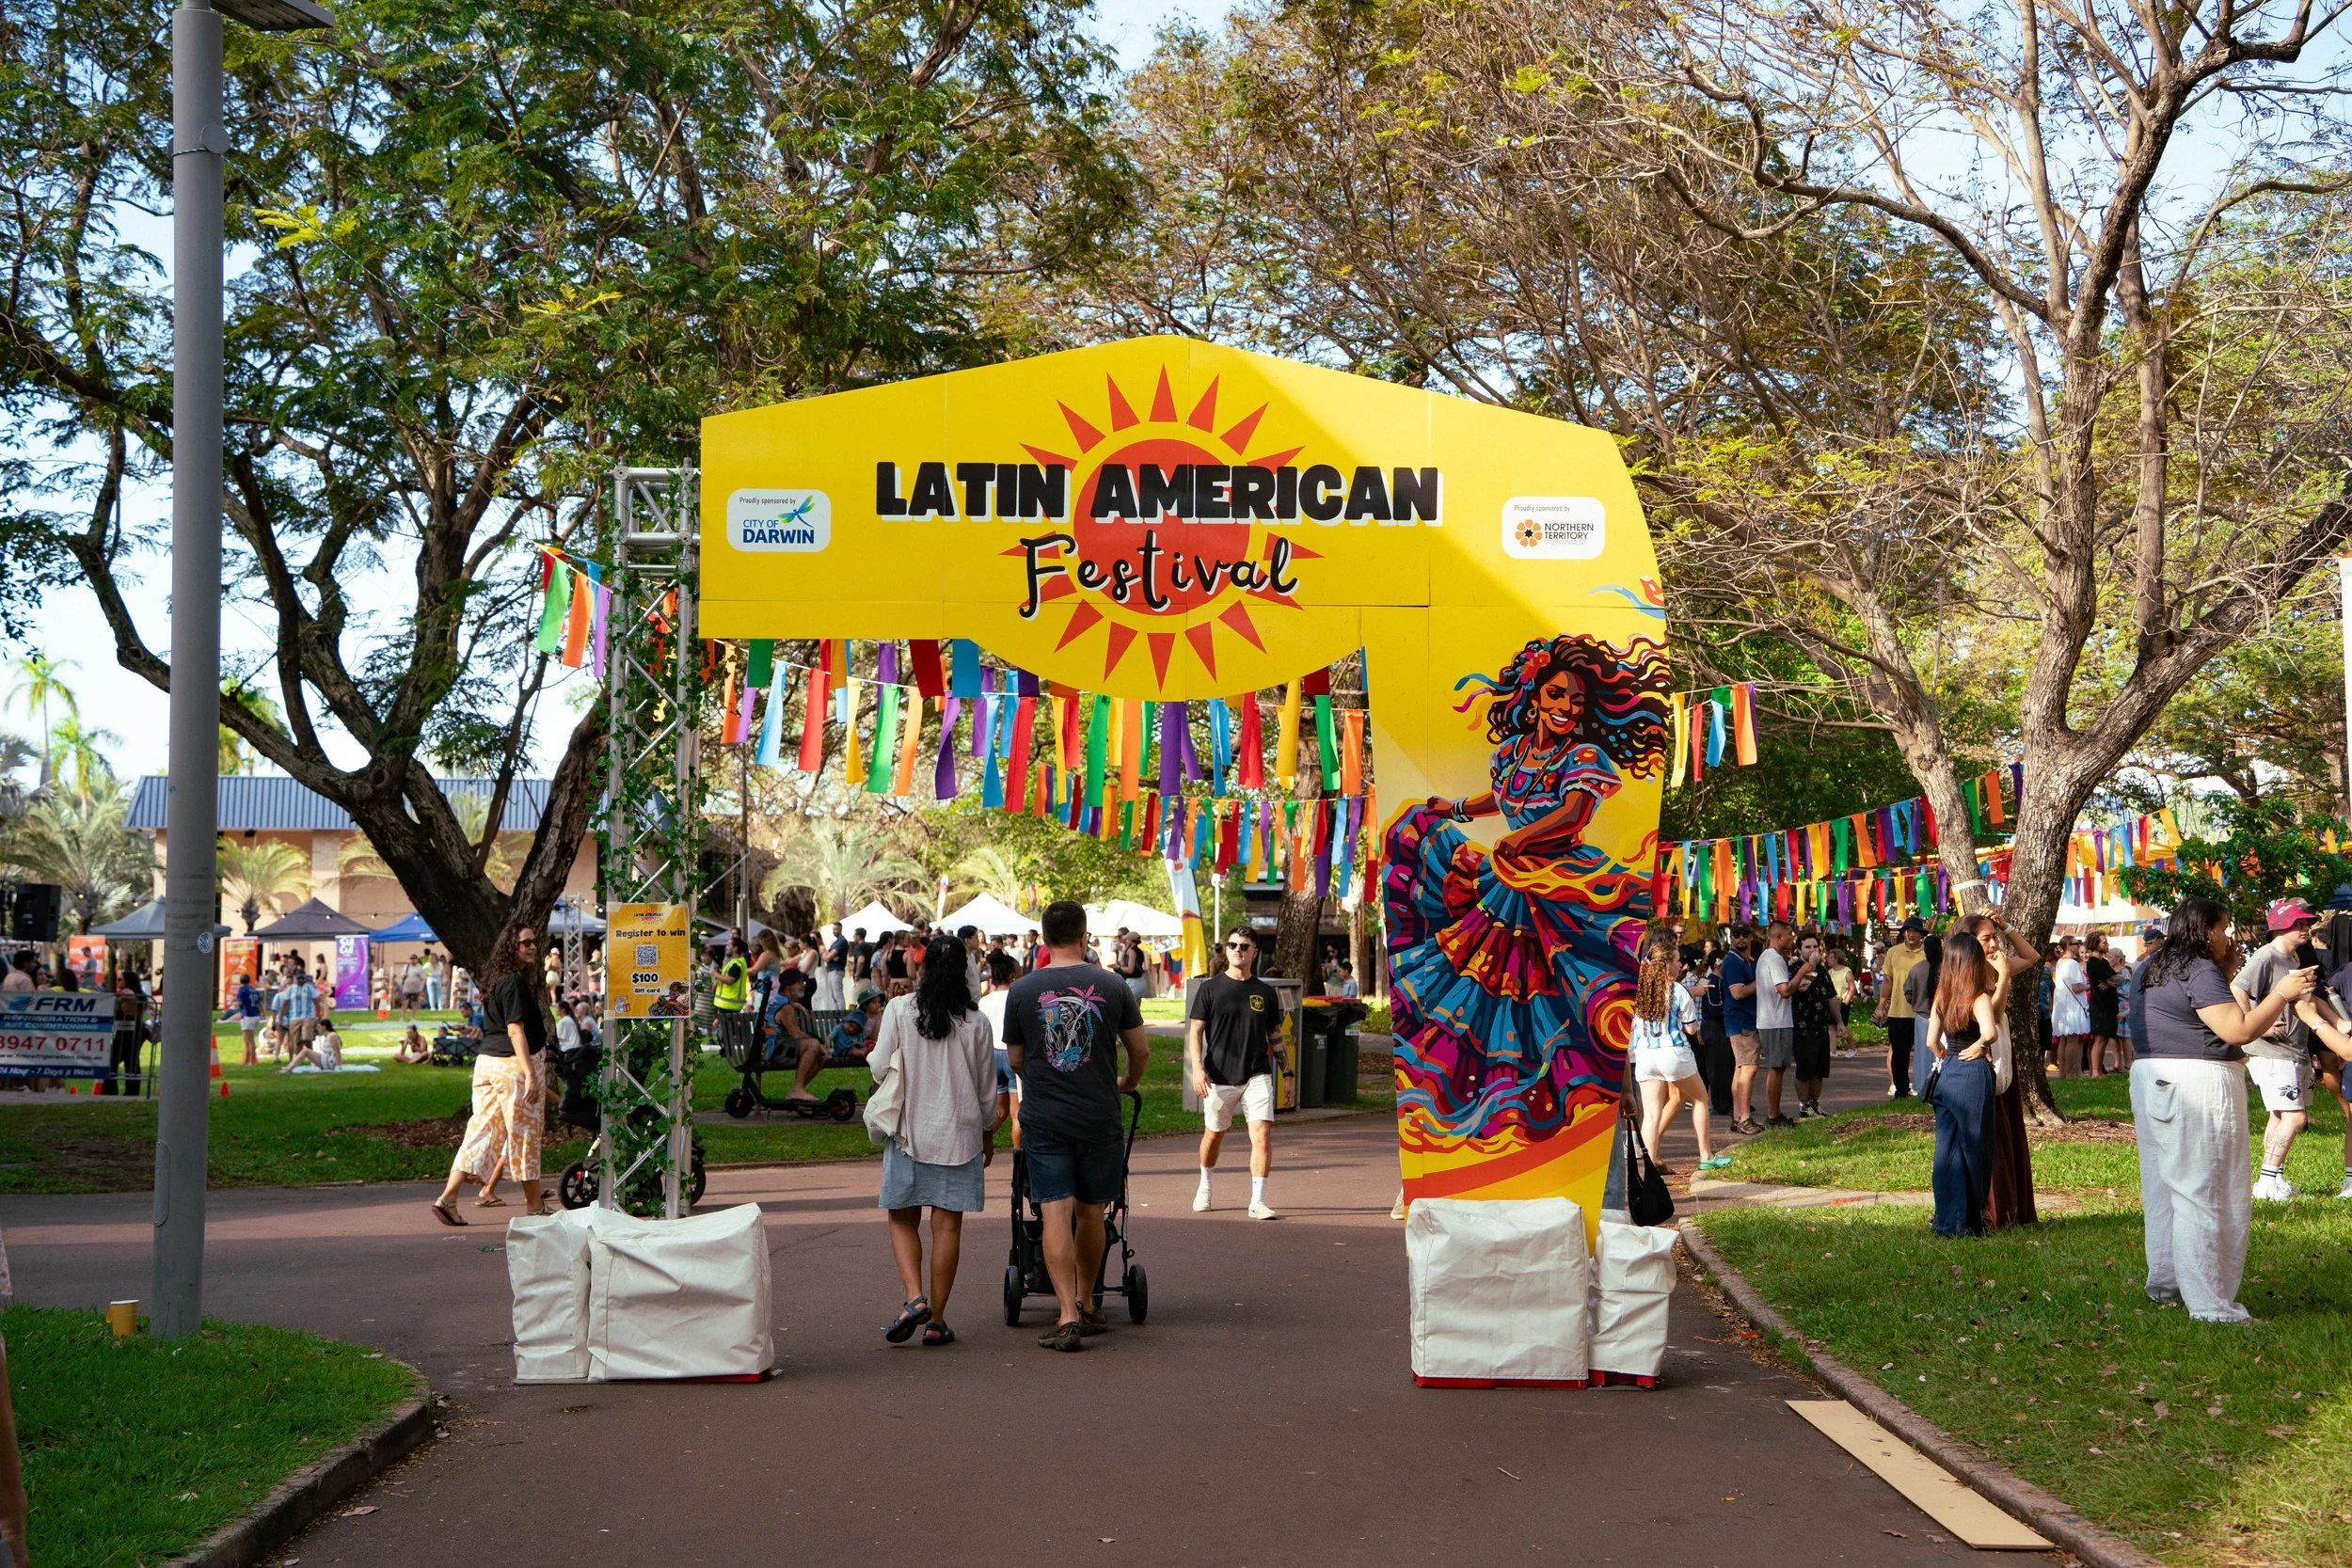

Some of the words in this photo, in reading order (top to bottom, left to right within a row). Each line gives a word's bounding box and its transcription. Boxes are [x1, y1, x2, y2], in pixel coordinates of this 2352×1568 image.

[876, 461, 1067, 519] LATIN
[1089, 464, 1438, 522] AMERICAN
[739, 497, 759, 505] Proudly
[743, 519, 764, 528] CITY
[767, 519, 779, 528] OF
[1544, 523, 1594, 531] NORTHERN
[742, 529, 815, 544] DARWIN
[1544, 531, 1588, 540] TERRITORY
[1019, 531, 1299, 619] Festival
[615, 928, 654, 939] Register
[657, 928, 666, 937] to
[670, 928, 686, 937] win
[631, 972, 659, 984] $100
[34, 997, 97, 1013] FRM
[4, 1015, 90, 1023] REFRIGERATION
[56, 1037, 104, 1052] 0711
[9, 1067, 29, 1076] Hour
[43, 1068, 64, 1076] Days
